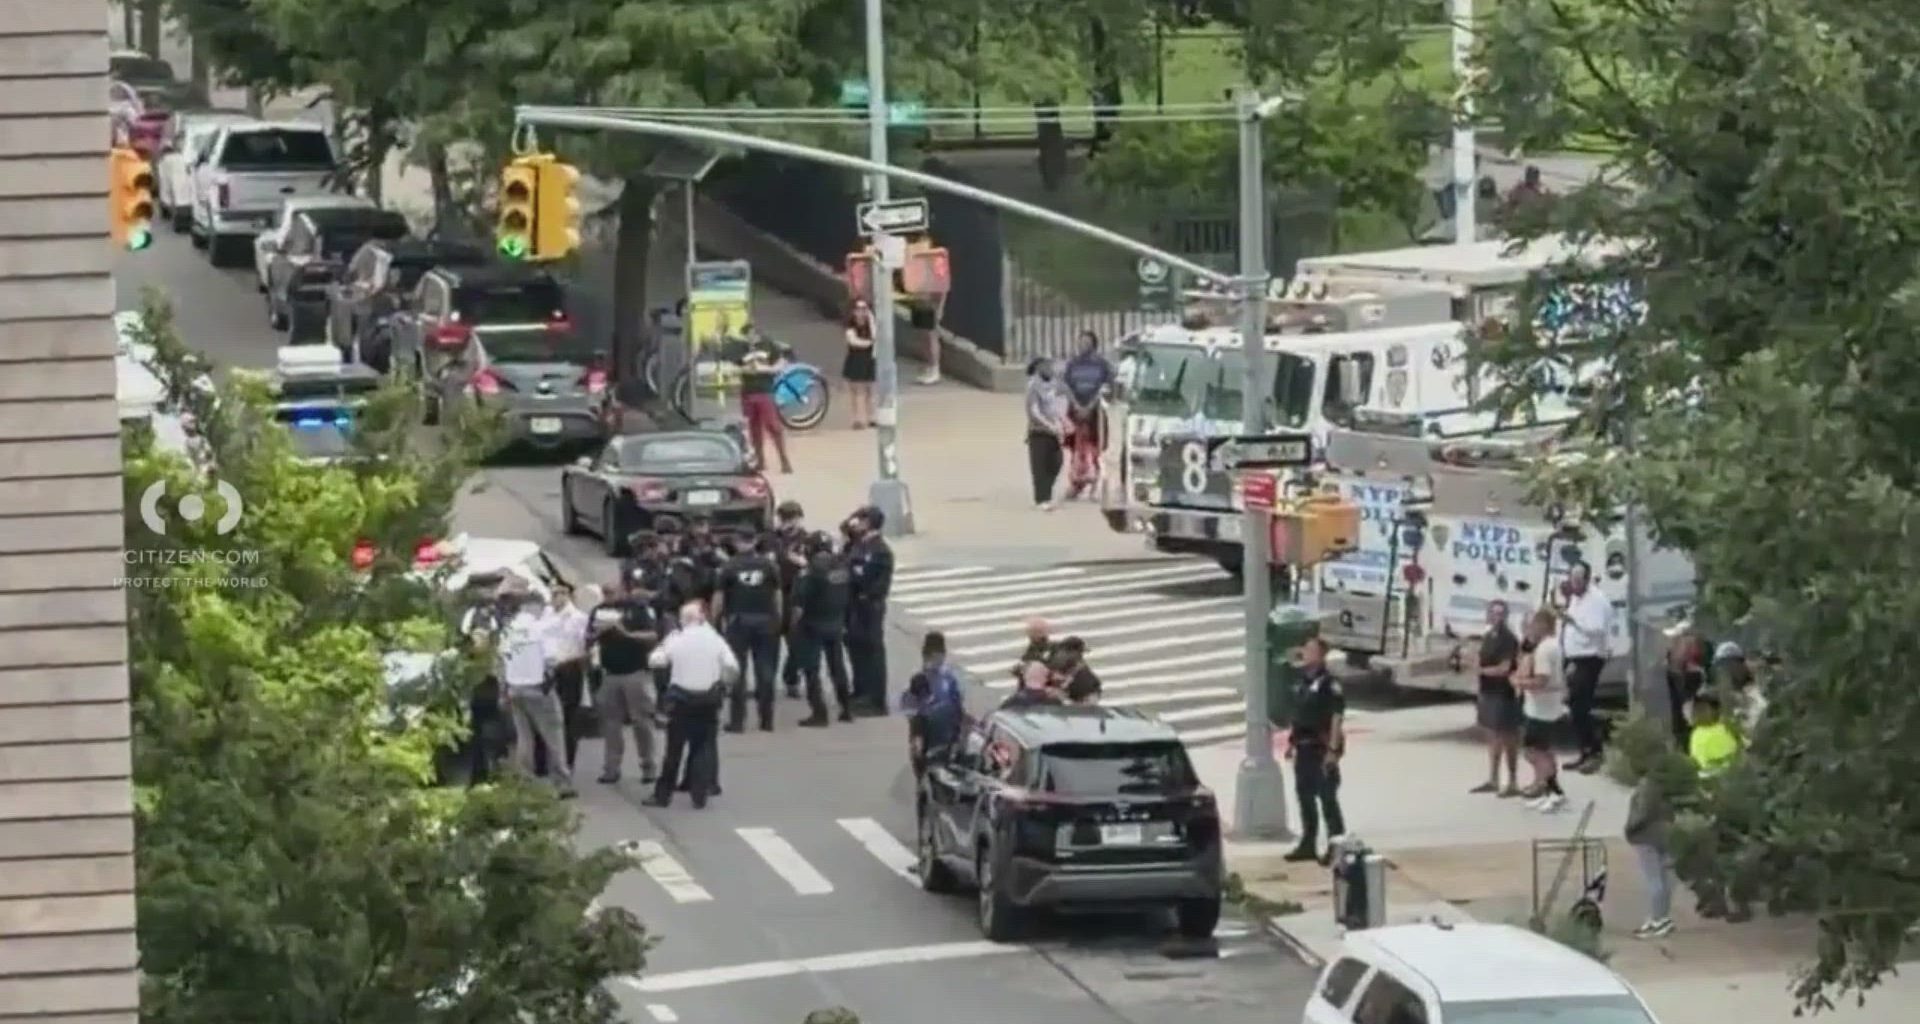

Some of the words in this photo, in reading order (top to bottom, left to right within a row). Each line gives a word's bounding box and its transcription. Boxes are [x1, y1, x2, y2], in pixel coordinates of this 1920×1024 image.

[1182, 442, 1207, 493] 8
[1462, 522, 1521, 544] NYPD
[1453, 541, 1532, 564] POLICE
